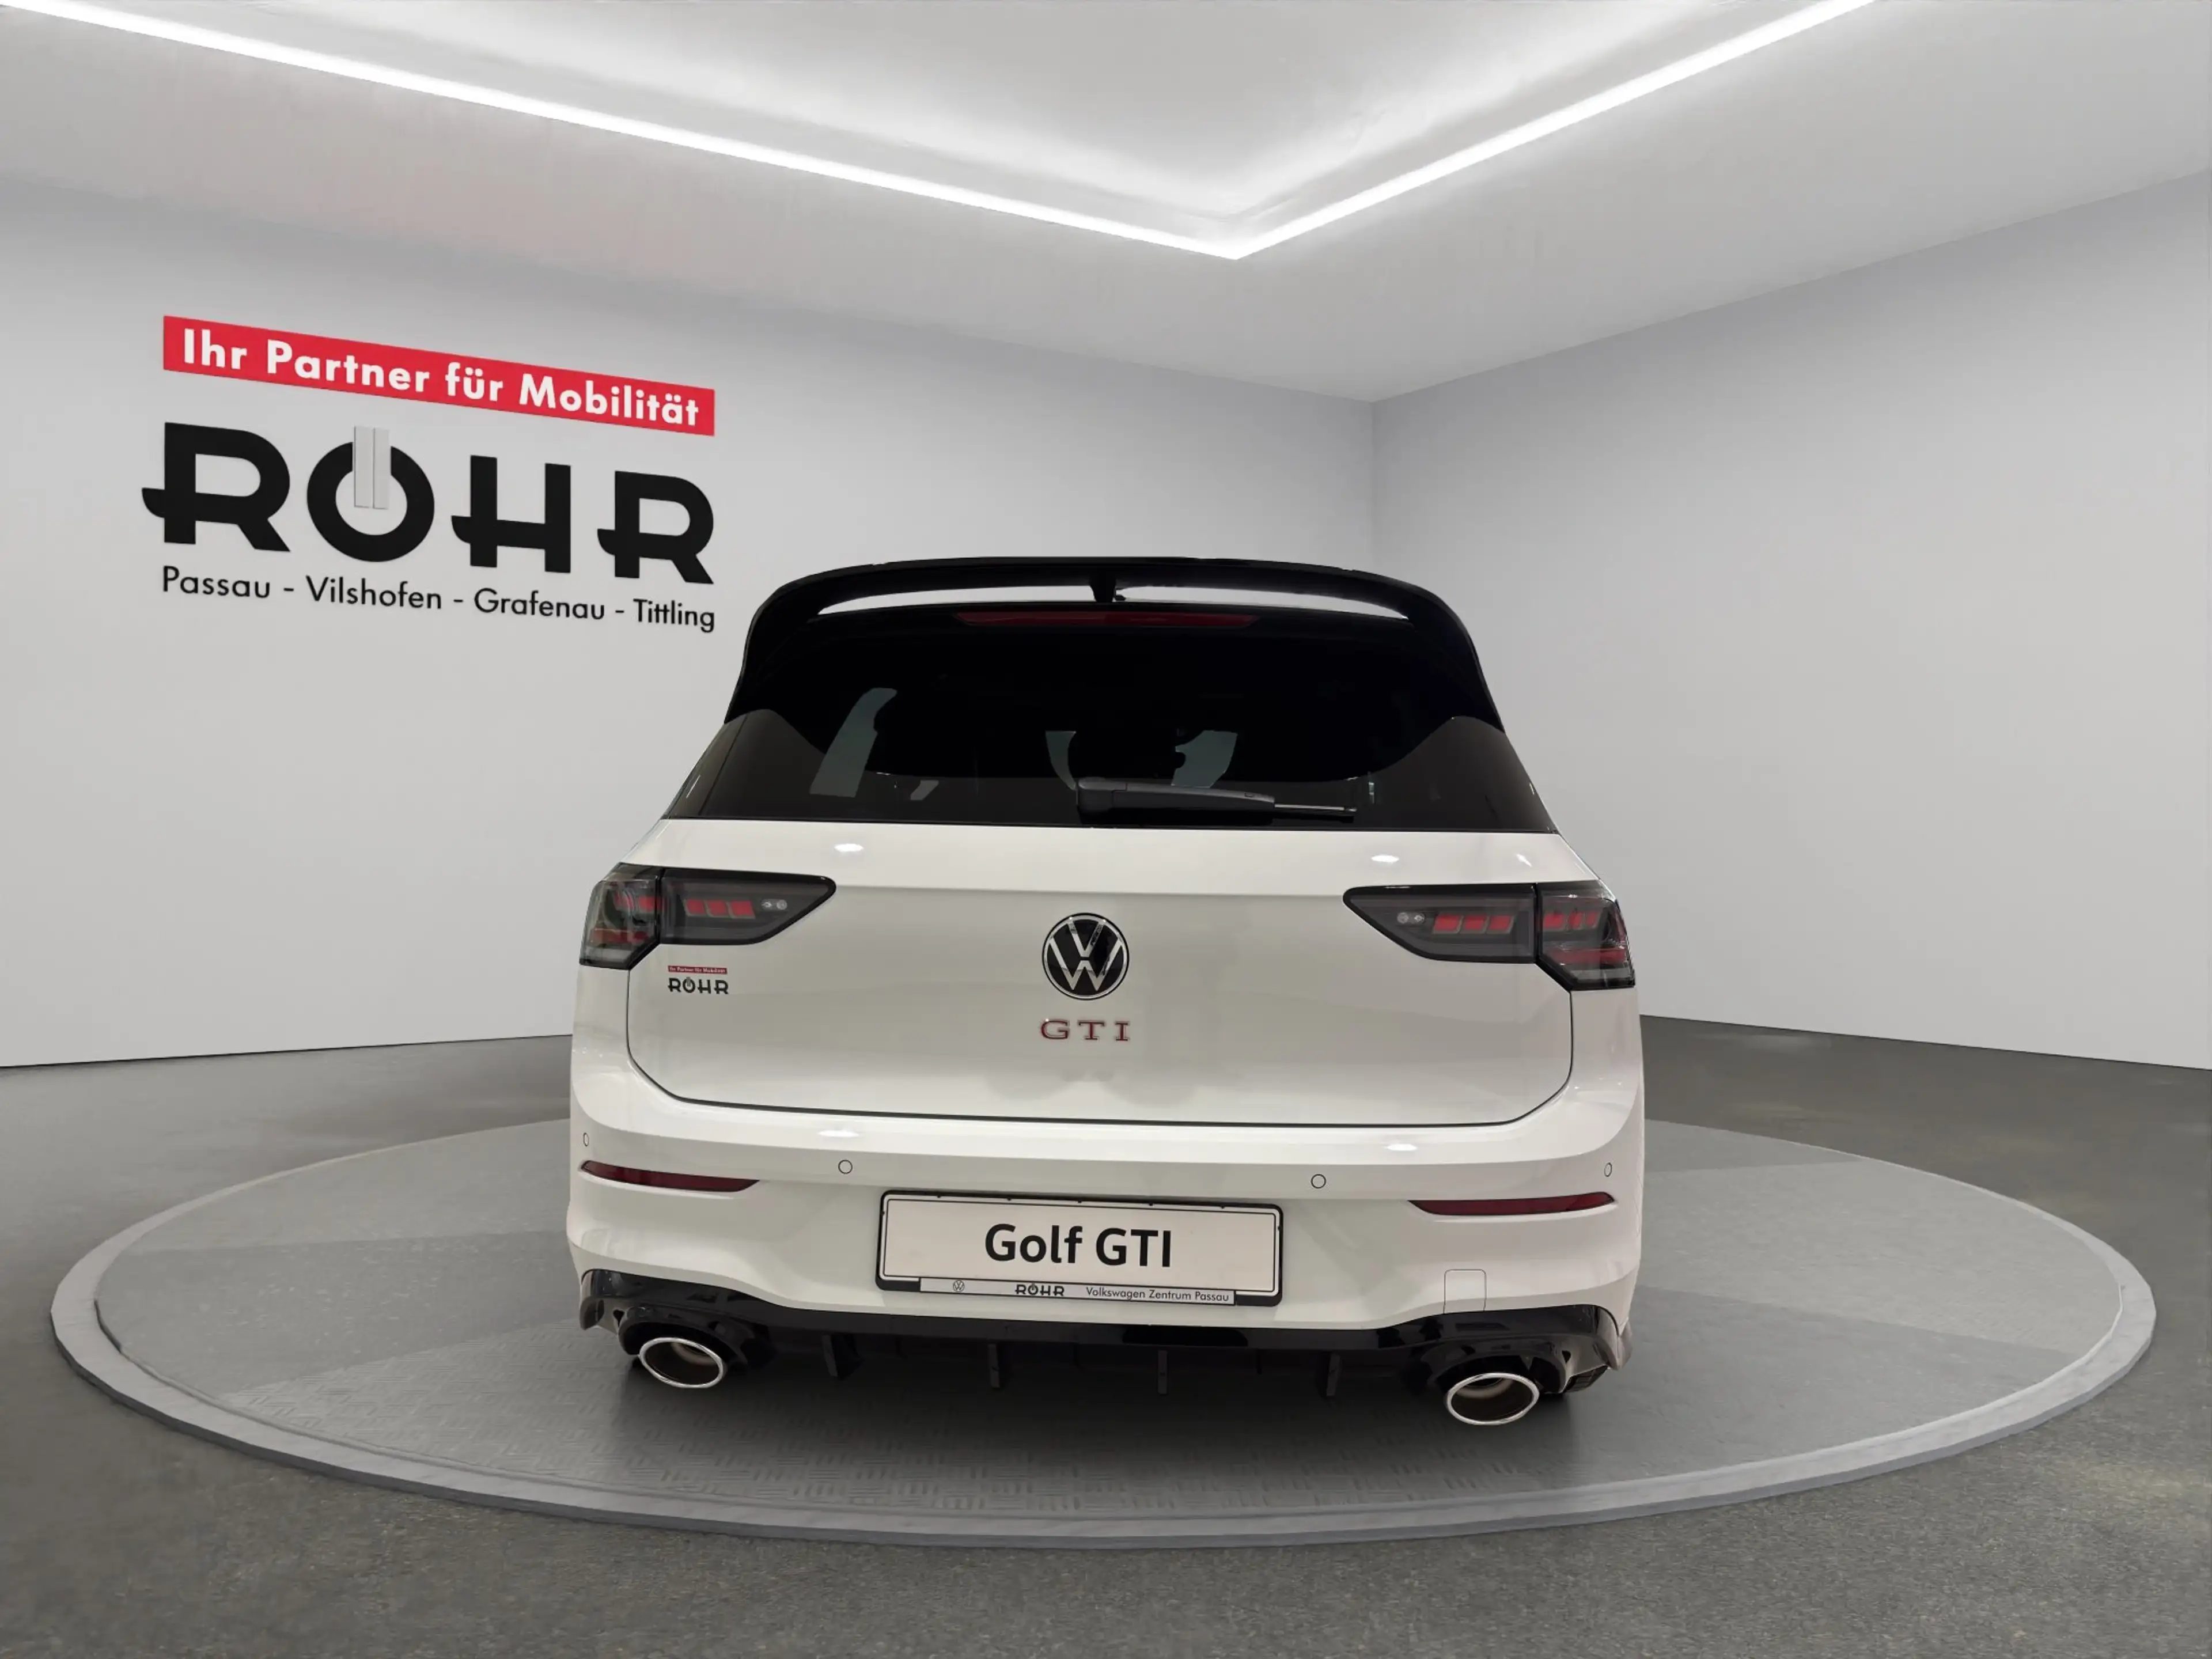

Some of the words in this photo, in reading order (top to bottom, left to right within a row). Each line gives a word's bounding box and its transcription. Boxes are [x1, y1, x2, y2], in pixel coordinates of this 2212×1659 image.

[184, 328, 247, 369] Ihr
[267, 339, 430, 392] Partner
[445, 362, 503, 402] für
[519, 373, 699, 426] Mobilität
[163, 565, 270, 599] Passau
[305, 575, 441, 609] Vilshofen
[474, 587, 605, 620] Grafenau
[632, 598, 715, 634] Tittling
[1040, 1017, 1130, 1041] GTI
[985, 1224, 1083, 1263] Golf
[1096, 1228, 1171, 1267] GTI
[1086, 1286, 1146, 1300] Volkswagen
[1149, 1289, 1191, 1300] Zentrum
[1195, 1290, 1229, 1301] Passau
